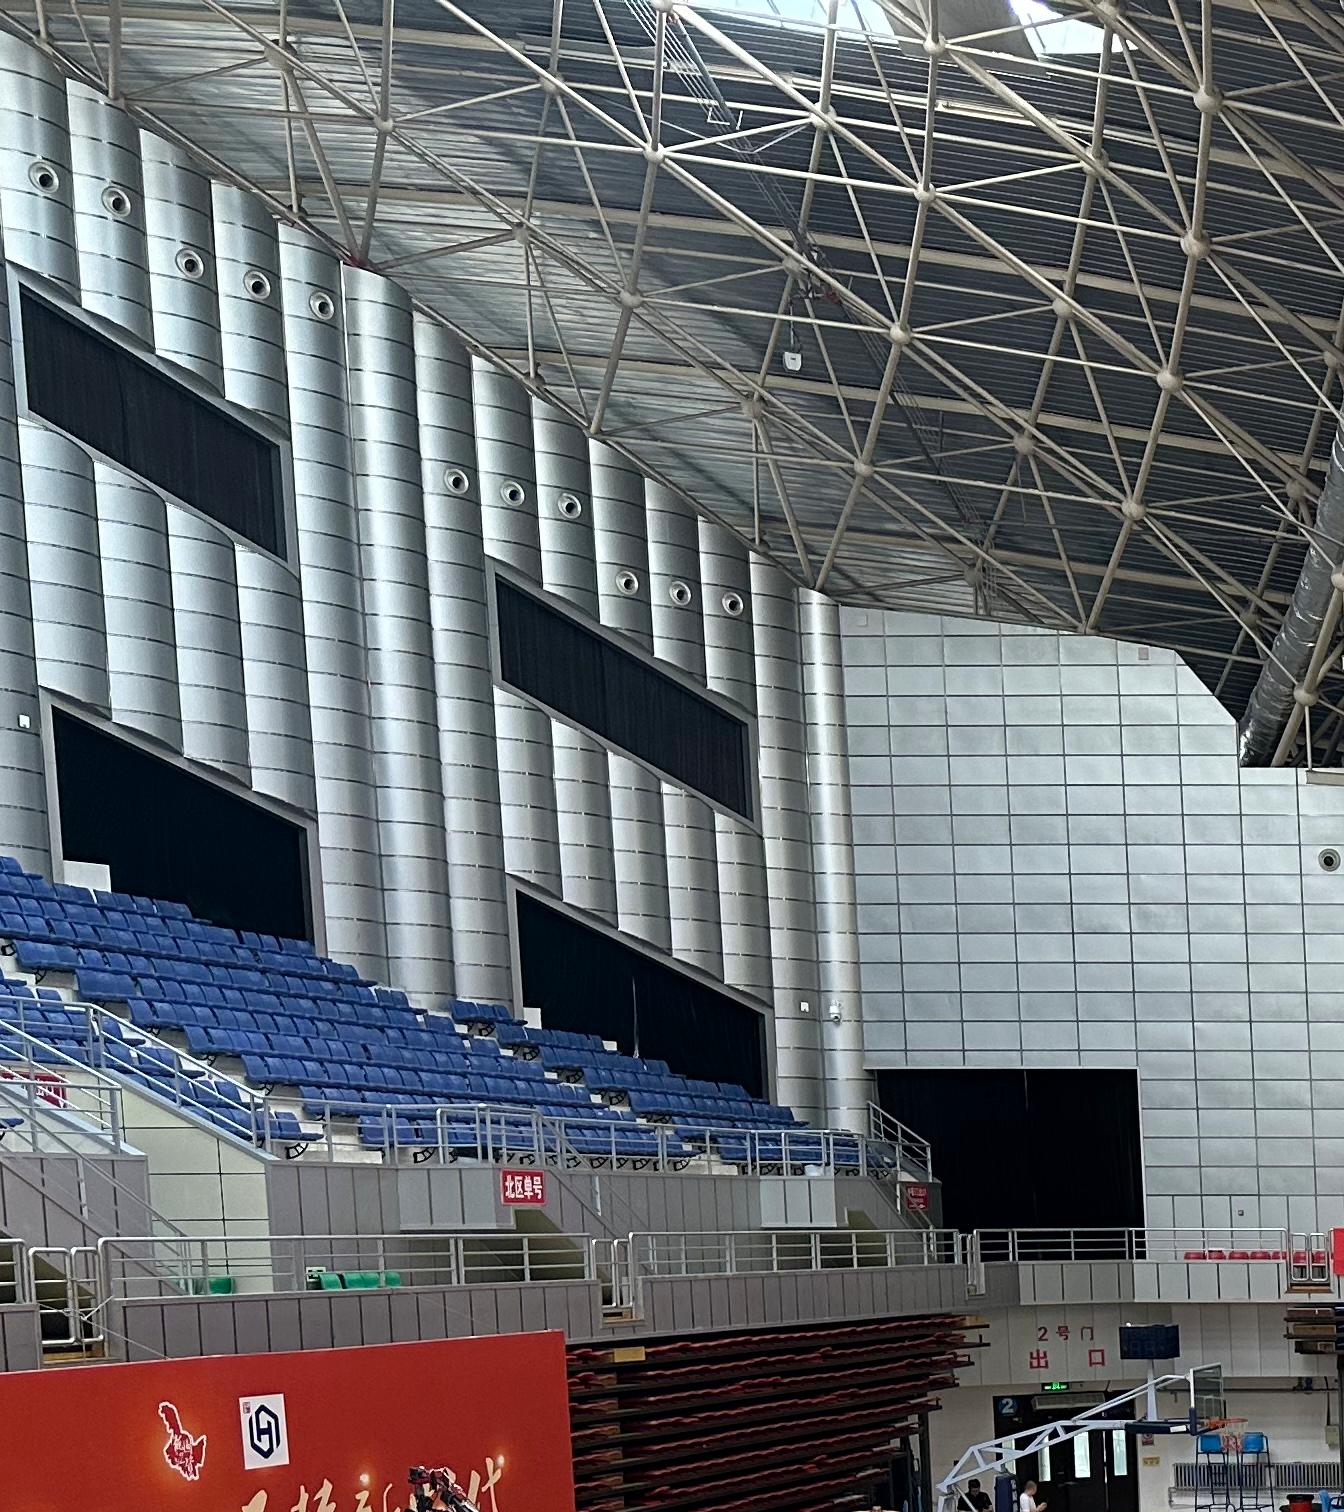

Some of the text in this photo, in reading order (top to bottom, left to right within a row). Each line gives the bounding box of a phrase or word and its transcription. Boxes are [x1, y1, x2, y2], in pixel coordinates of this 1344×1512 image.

[504, 1174, 544, 1201] 北区单号
[1037, 1325, 1095, 1341] 2号门
[1029, 1348, 1106, 1370] 出口
[1001, 1398, 1015, 1414] 2
